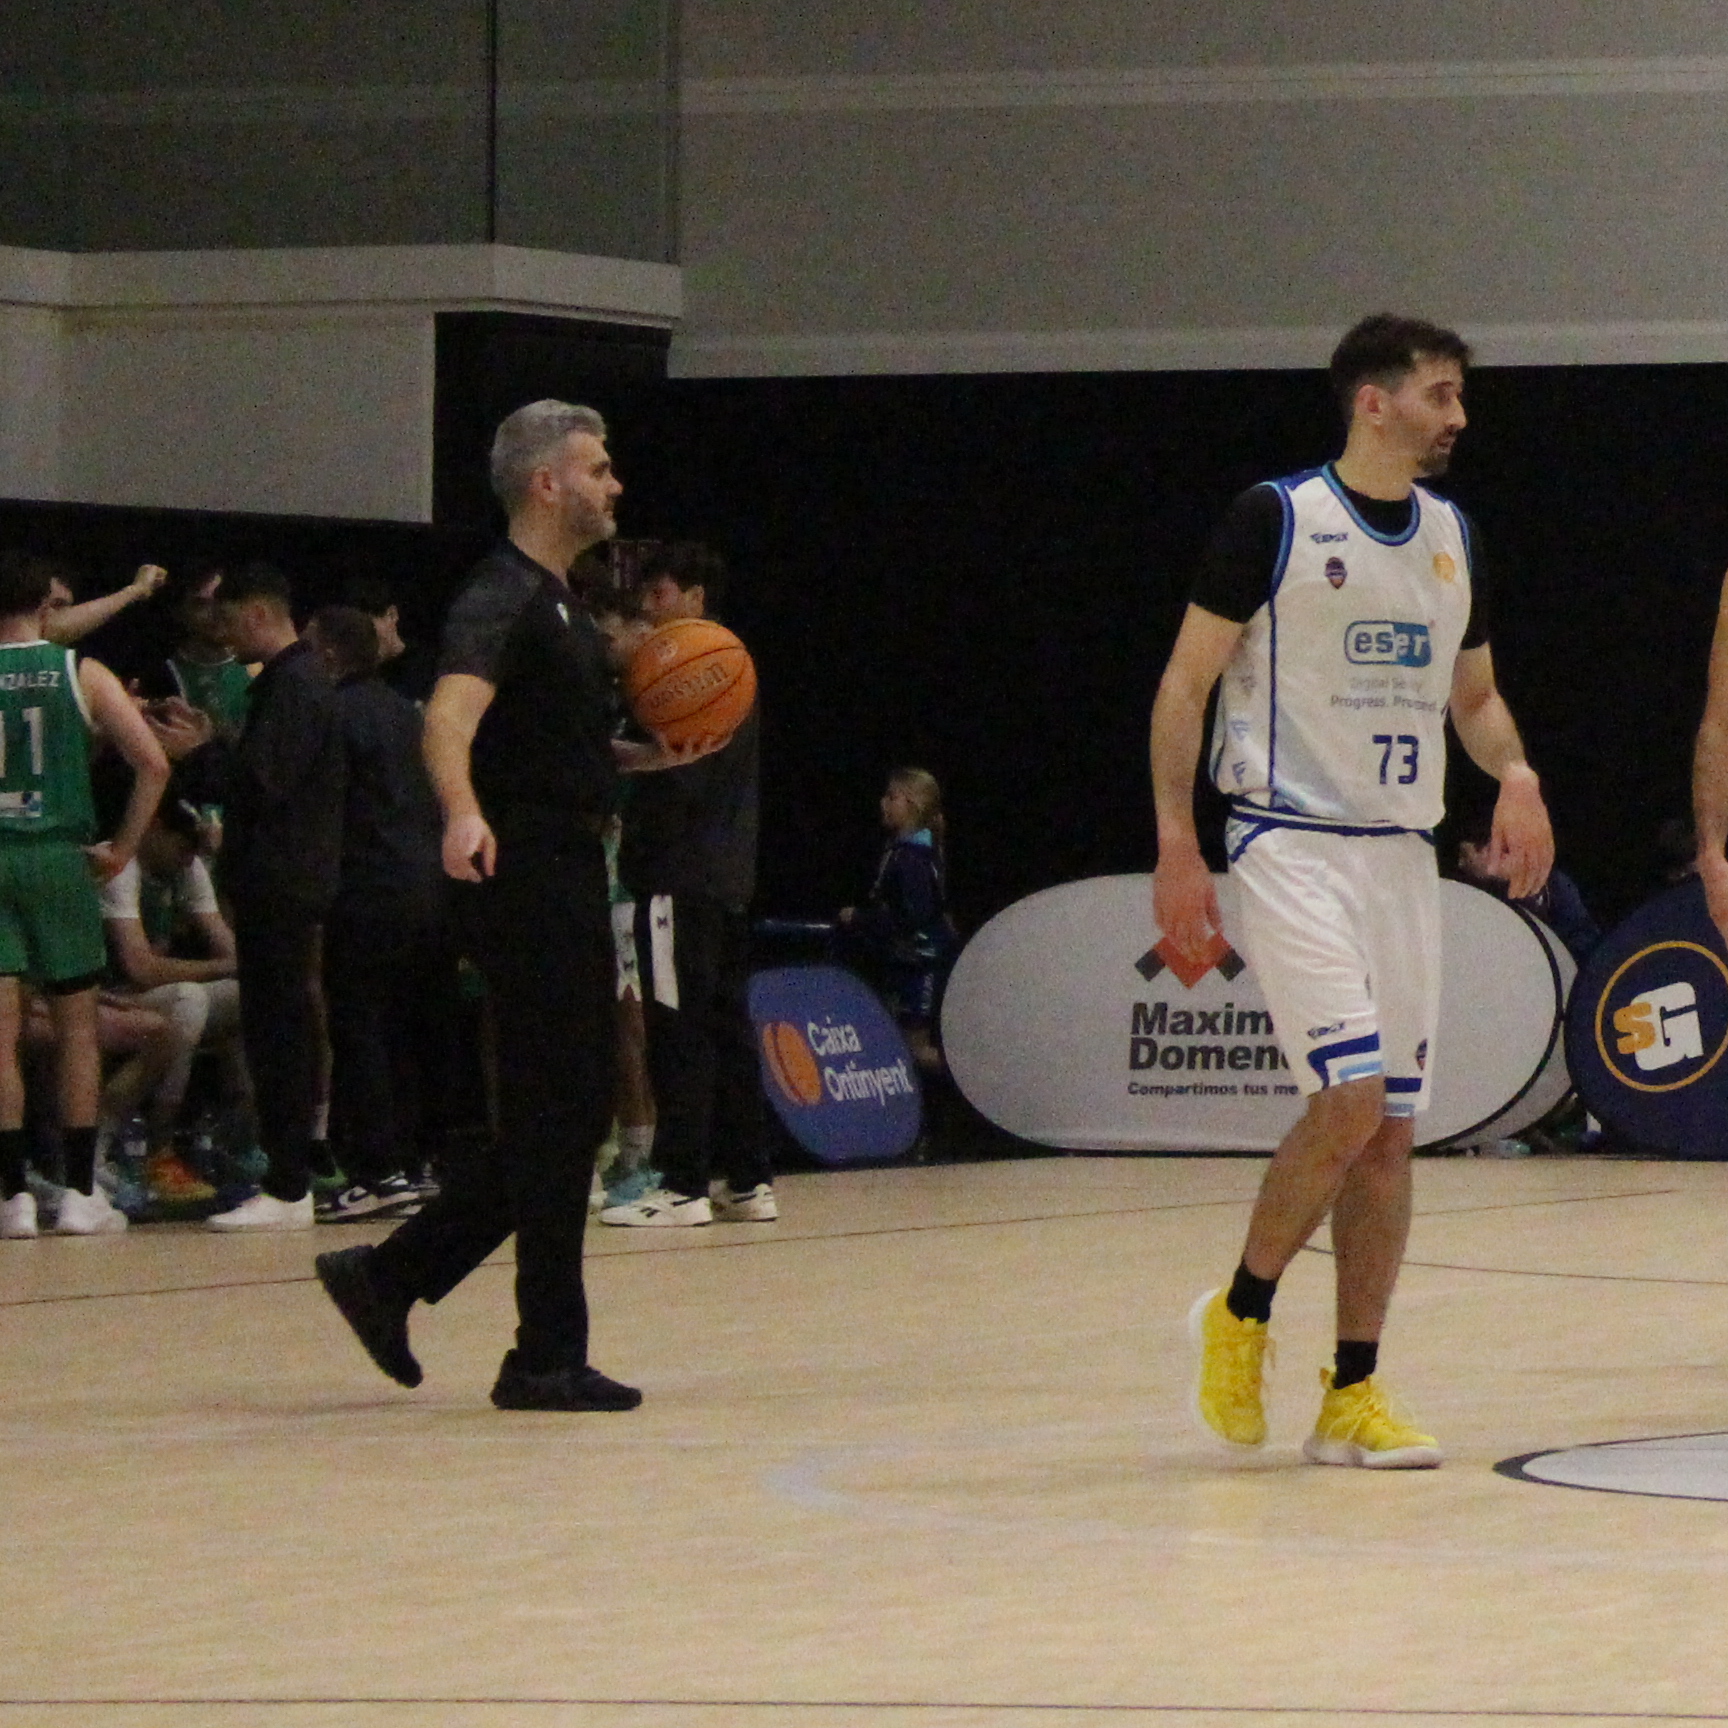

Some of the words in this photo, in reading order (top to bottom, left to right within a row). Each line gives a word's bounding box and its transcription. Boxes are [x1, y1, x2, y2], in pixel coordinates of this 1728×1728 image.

[1372, 734, 1419, 785] 73
[806, 1015, 863, 1056] Caixa
[1127, 1083, 1238, 1097] Compartimos
[1243, 1082, 1268, 1095] tus
